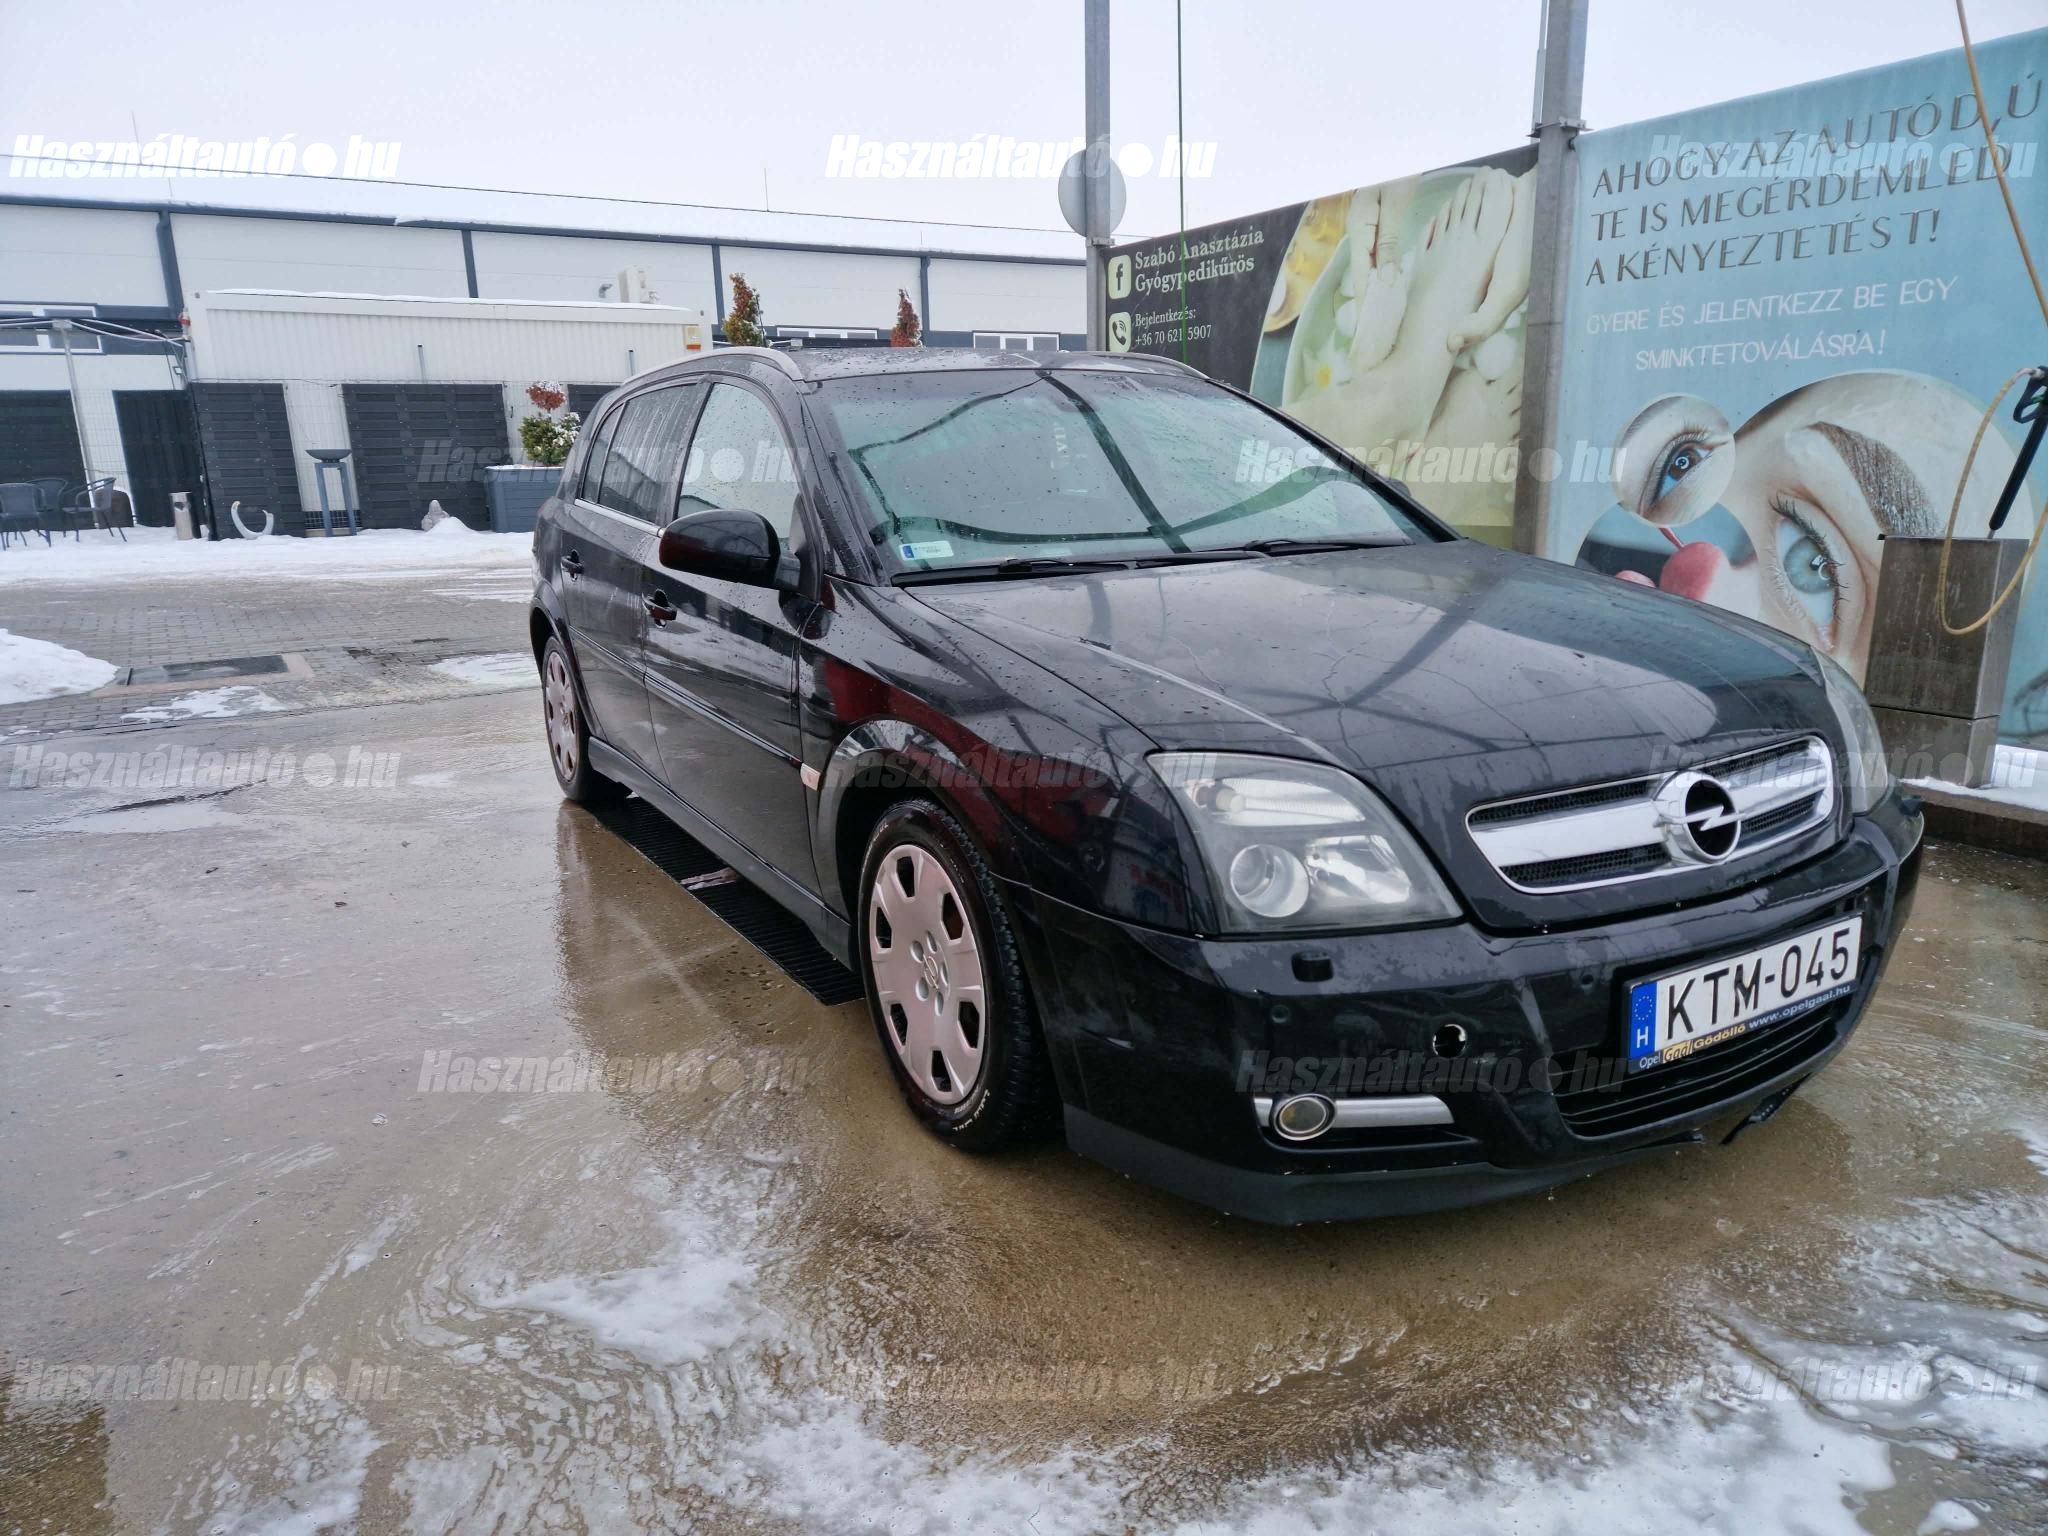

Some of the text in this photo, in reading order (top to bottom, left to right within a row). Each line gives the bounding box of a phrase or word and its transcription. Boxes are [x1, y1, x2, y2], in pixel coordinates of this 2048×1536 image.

[1593, 142, 1730, 198] AHOGY
[1741, 129, 1798, 171] AZ
[1591, 144, 2012, 241] TE IS MEGÉRDEMLED
[1135, 226, 1264, 270] Szabó Anasztázia
[1586, 208, 1941, 287] A KÉNYEZTETÉST!
[1135, 254, 1255, 295] Gyógypedikűrös
[1135, 306, 1196, 330] Bejelentkezés:
[1586, 276, 1958, 335] GYERE ÉS JELENTKEZZ BE EGY
[1135, 325, 1212, 347] +36 70 621 5907
[1635, 329, 1886, 371] SMINKTETOVÁLÁSRA!
[1666, 927, 1850, 1041] KTM-045
[1636, 1025, 1649, 1049] H
[1640, 1052, 1661, 1069] Opel
[1749, 985, 1851, 1029] www.opelgaal.hu
